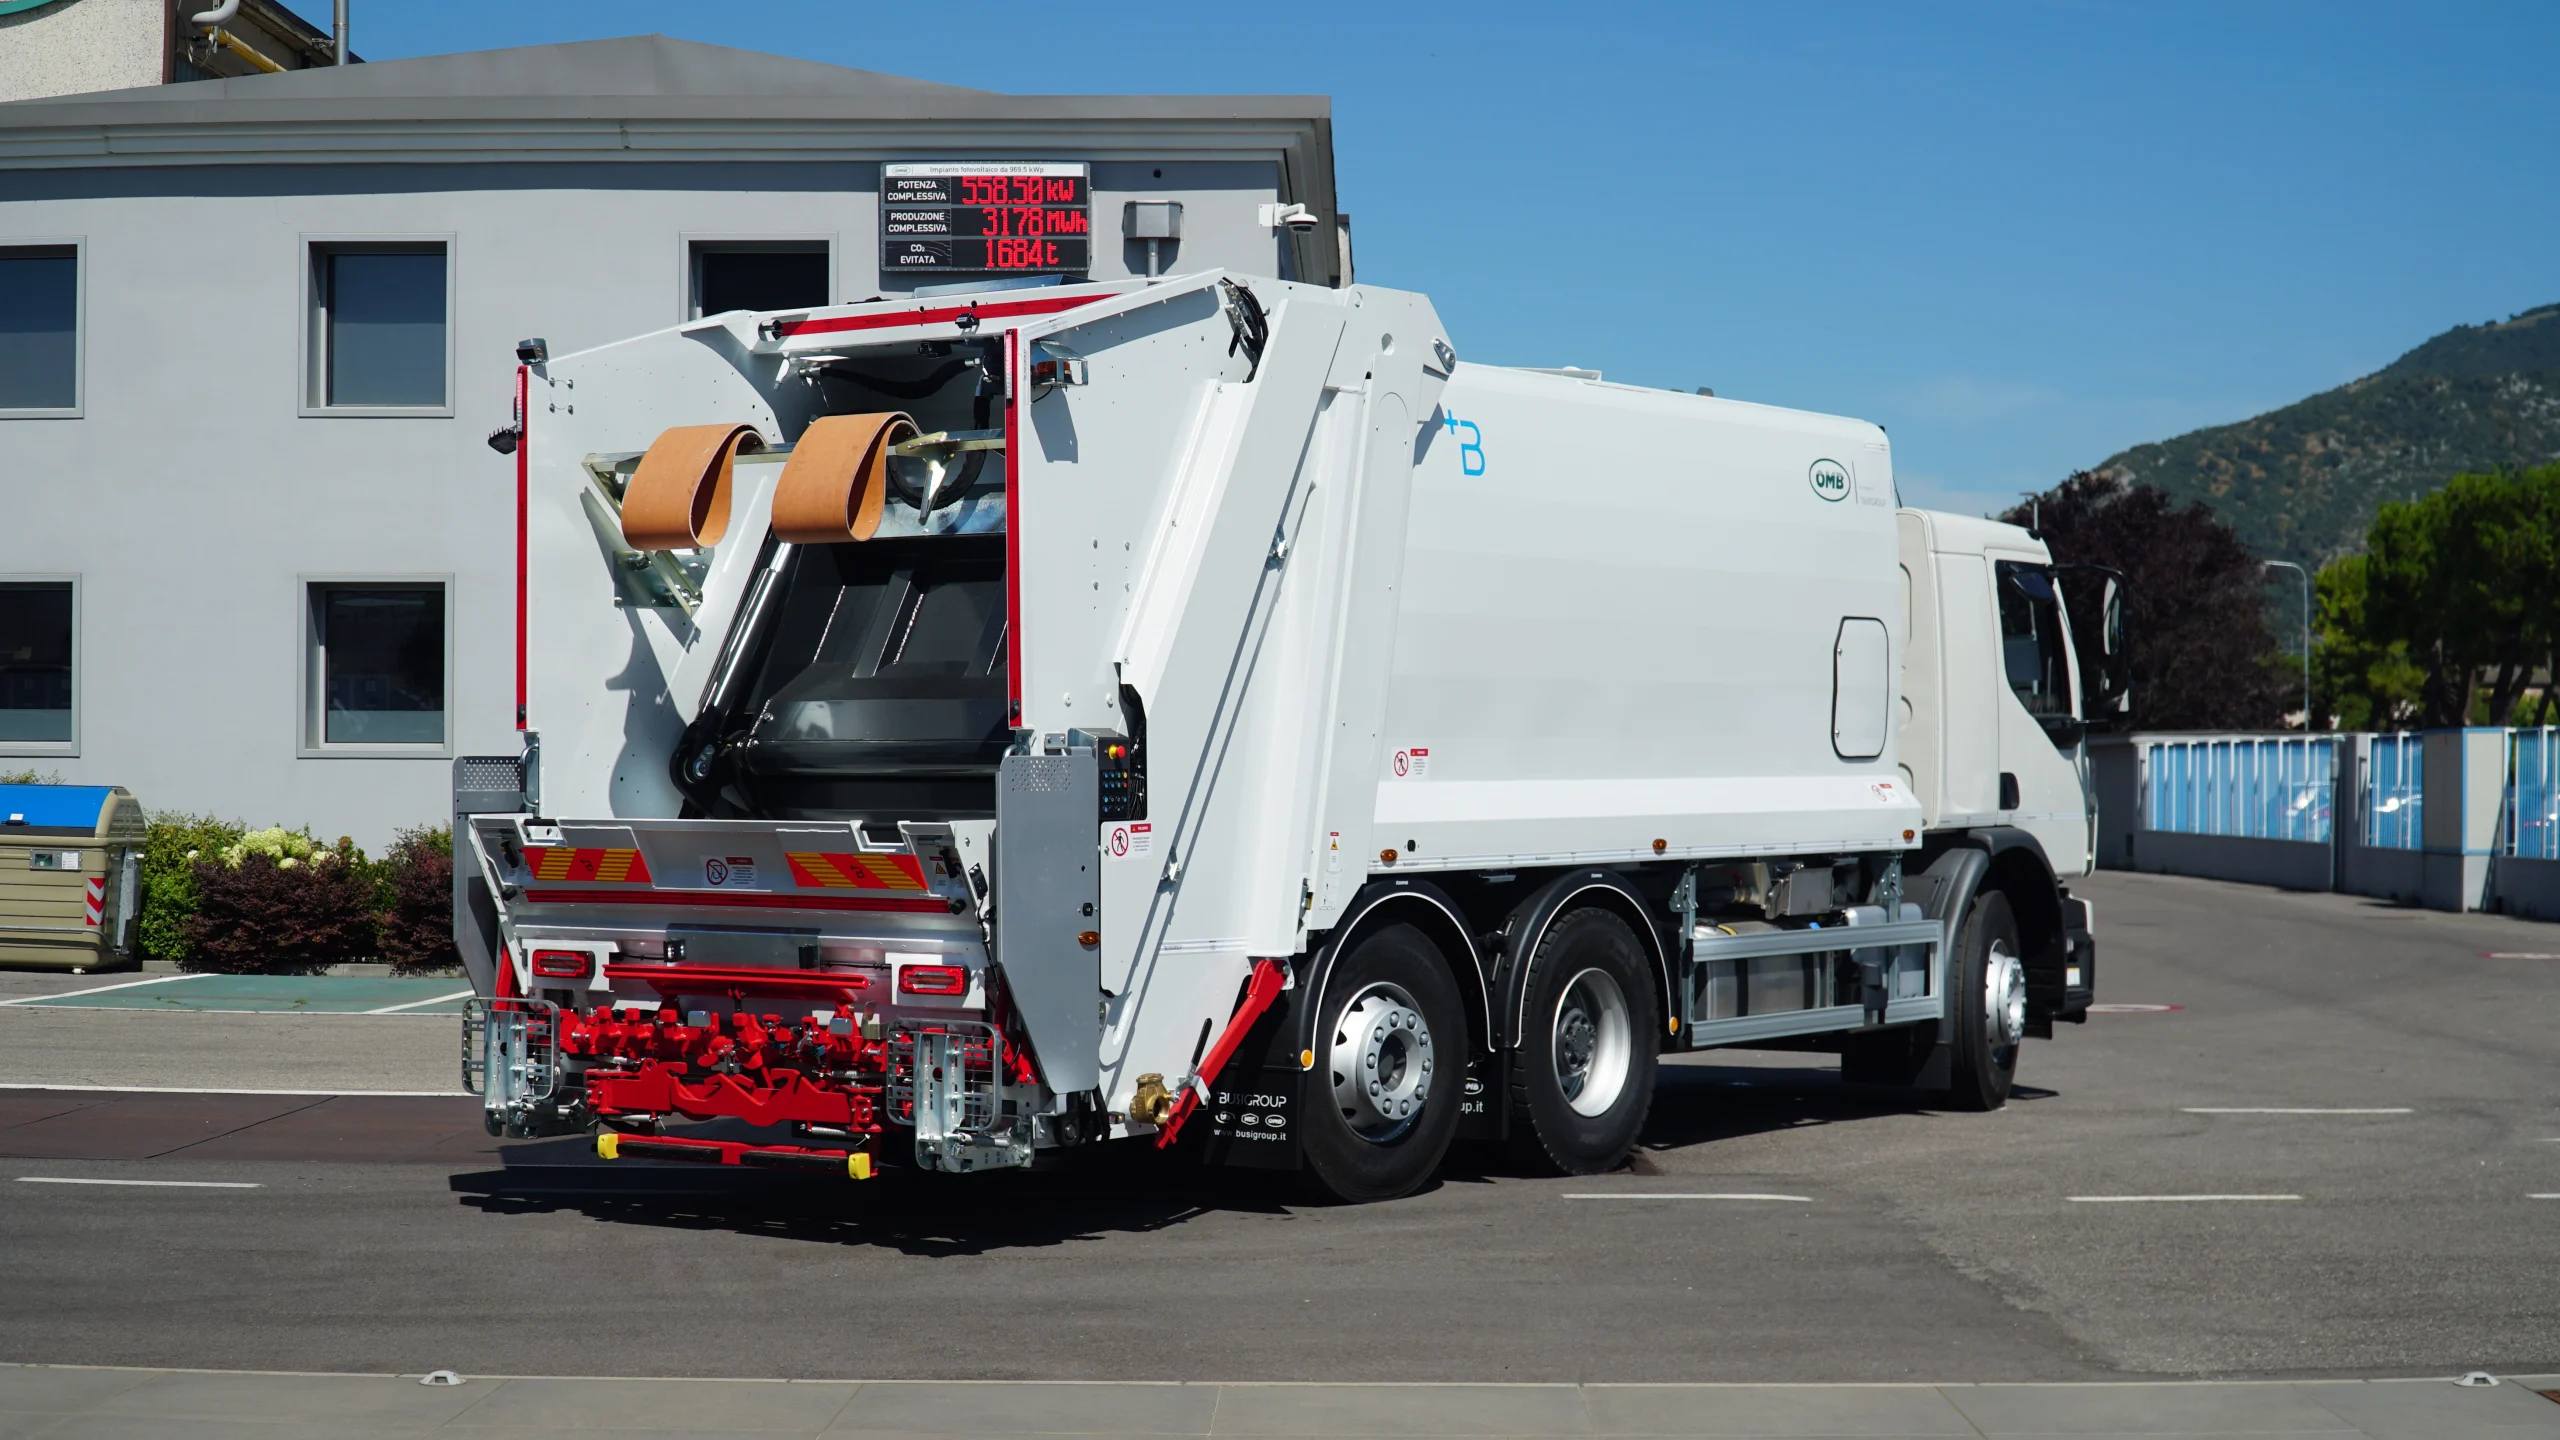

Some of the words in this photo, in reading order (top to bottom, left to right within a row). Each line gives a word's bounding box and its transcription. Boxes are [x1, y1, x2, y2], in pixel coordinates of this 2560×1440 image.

[930, 166, 959, 174] Impianto
[960, 165, 998, 173] fotovoltaico
[1029, 166, 1044, 174] kWp
[897, 180, 937, 190] POTENZA
[962, 176, 1044, 205] 558.50
[1047, 179, 1074, 202] kW
[887, 192, 947, 201] COMPLESSIVA
[890, 212, 945, 221] PRODUZIONE
[982, 207, 1044, 236] 3178
[1047, 211, 1088, 233] MWh
[888, 223, 947, 233] COMPLESSIVA
[985, 239, 1044, 268] 1684
[1047, 242, 1059, 264] t
[900, 255, 936, 265] EVITATA
[1815, 469, 1844, 490] OMB
